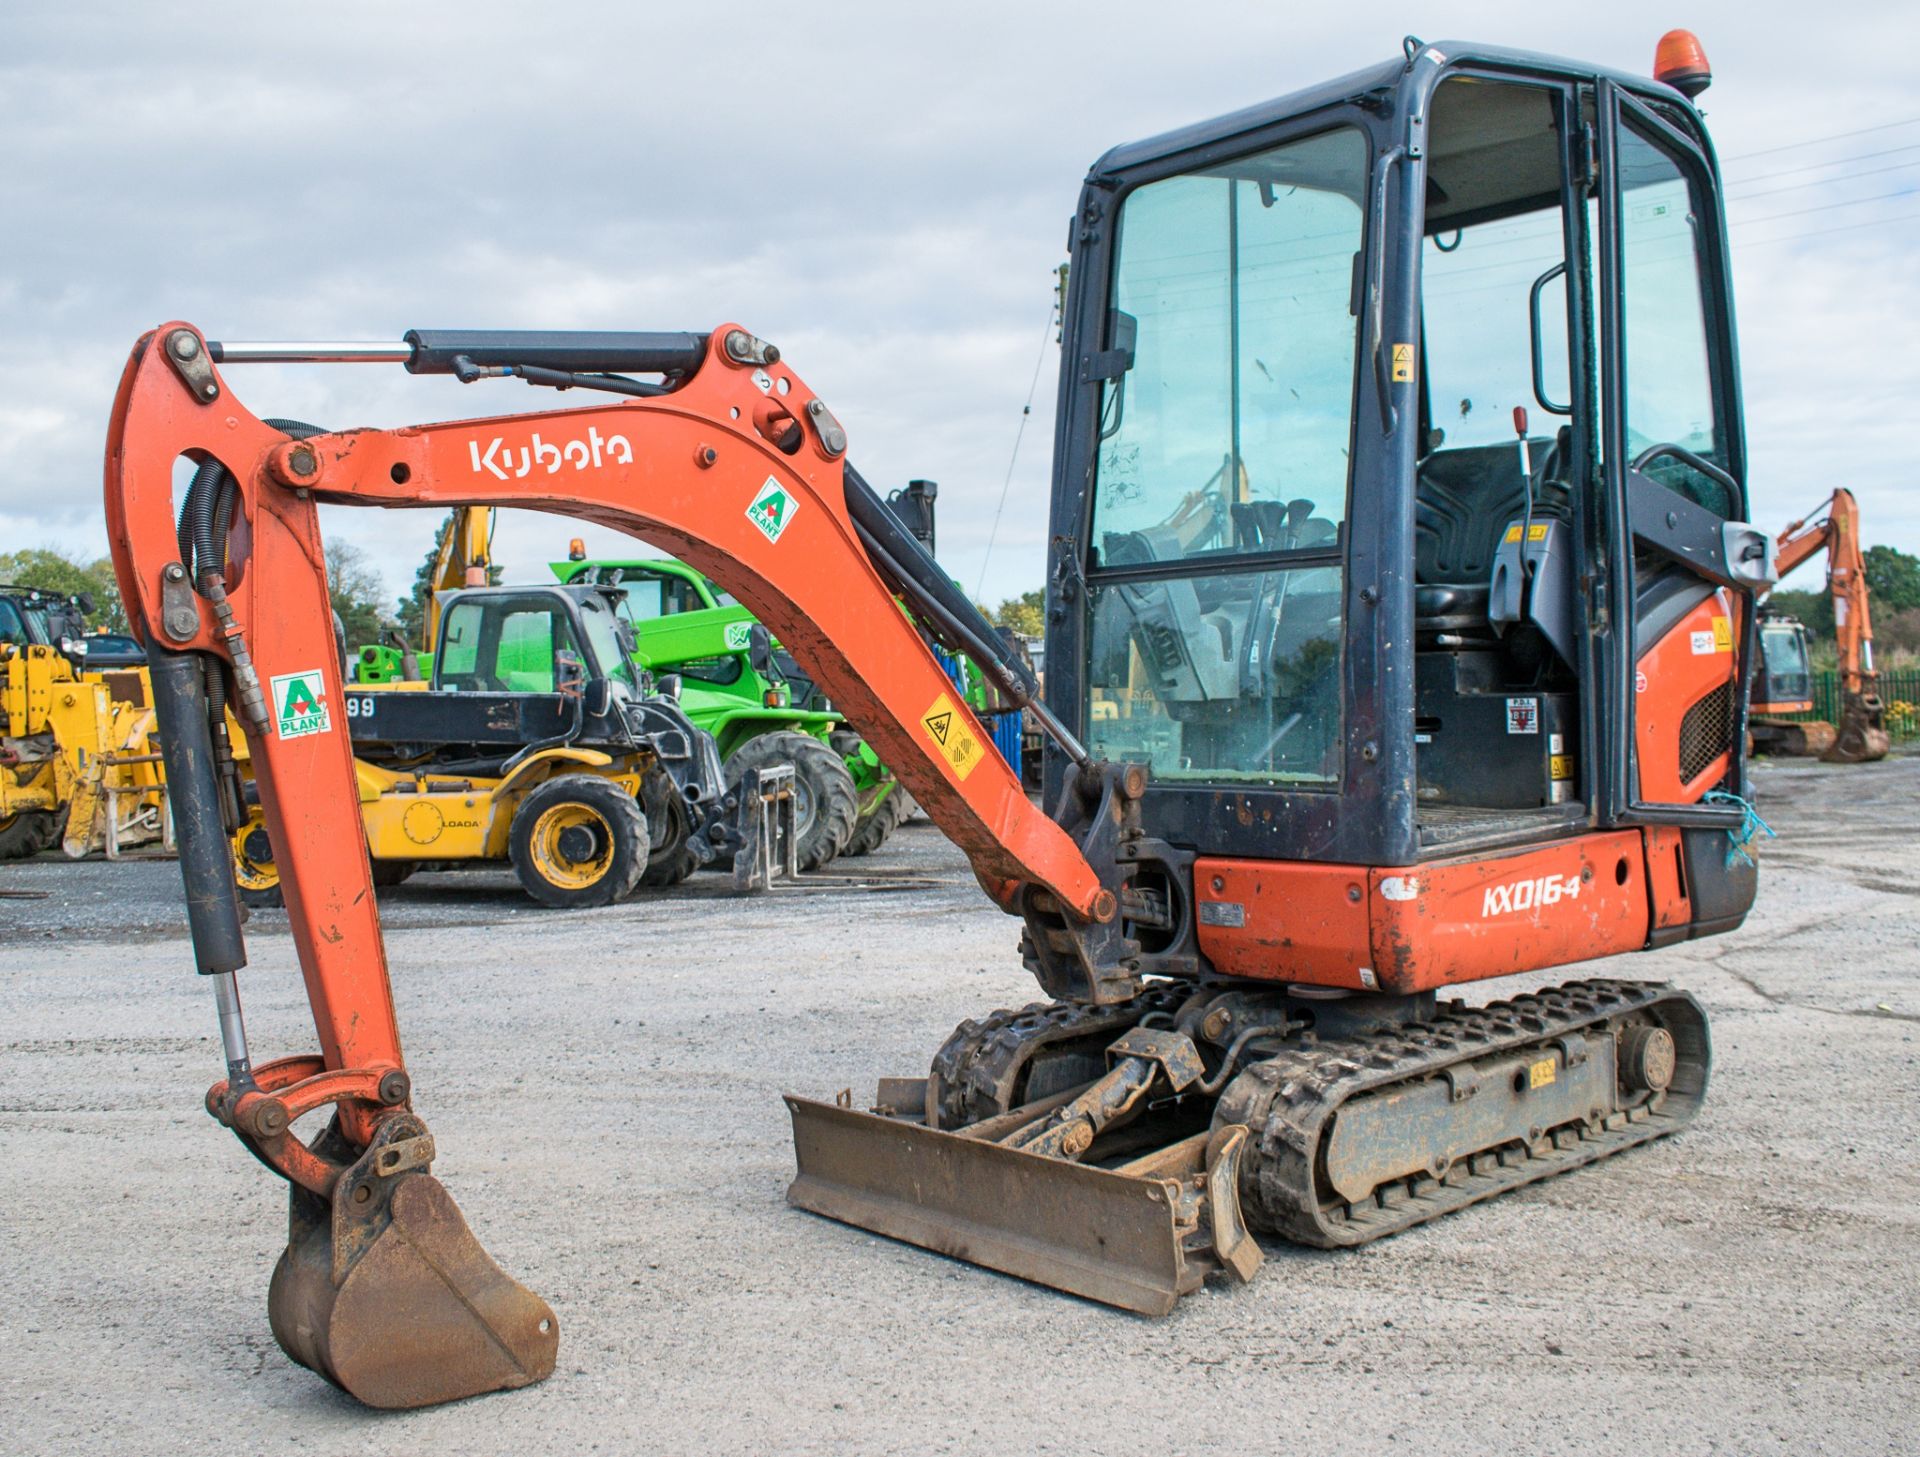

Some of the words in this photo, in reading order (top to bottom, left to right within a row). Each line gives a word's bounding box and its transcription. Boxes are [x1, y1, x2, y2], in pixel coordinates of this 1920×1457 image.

[469, 427, 633, 480] Kubota
[749, 506, 779, 537] PLANT
[757, 491, 786, 528] A
[283, 680, 322, 719] A
[347, 698, 374, 717] 99
[280, 715, 327, 734] PLANT
[1482, 874, 1580, 917] KX016-4
